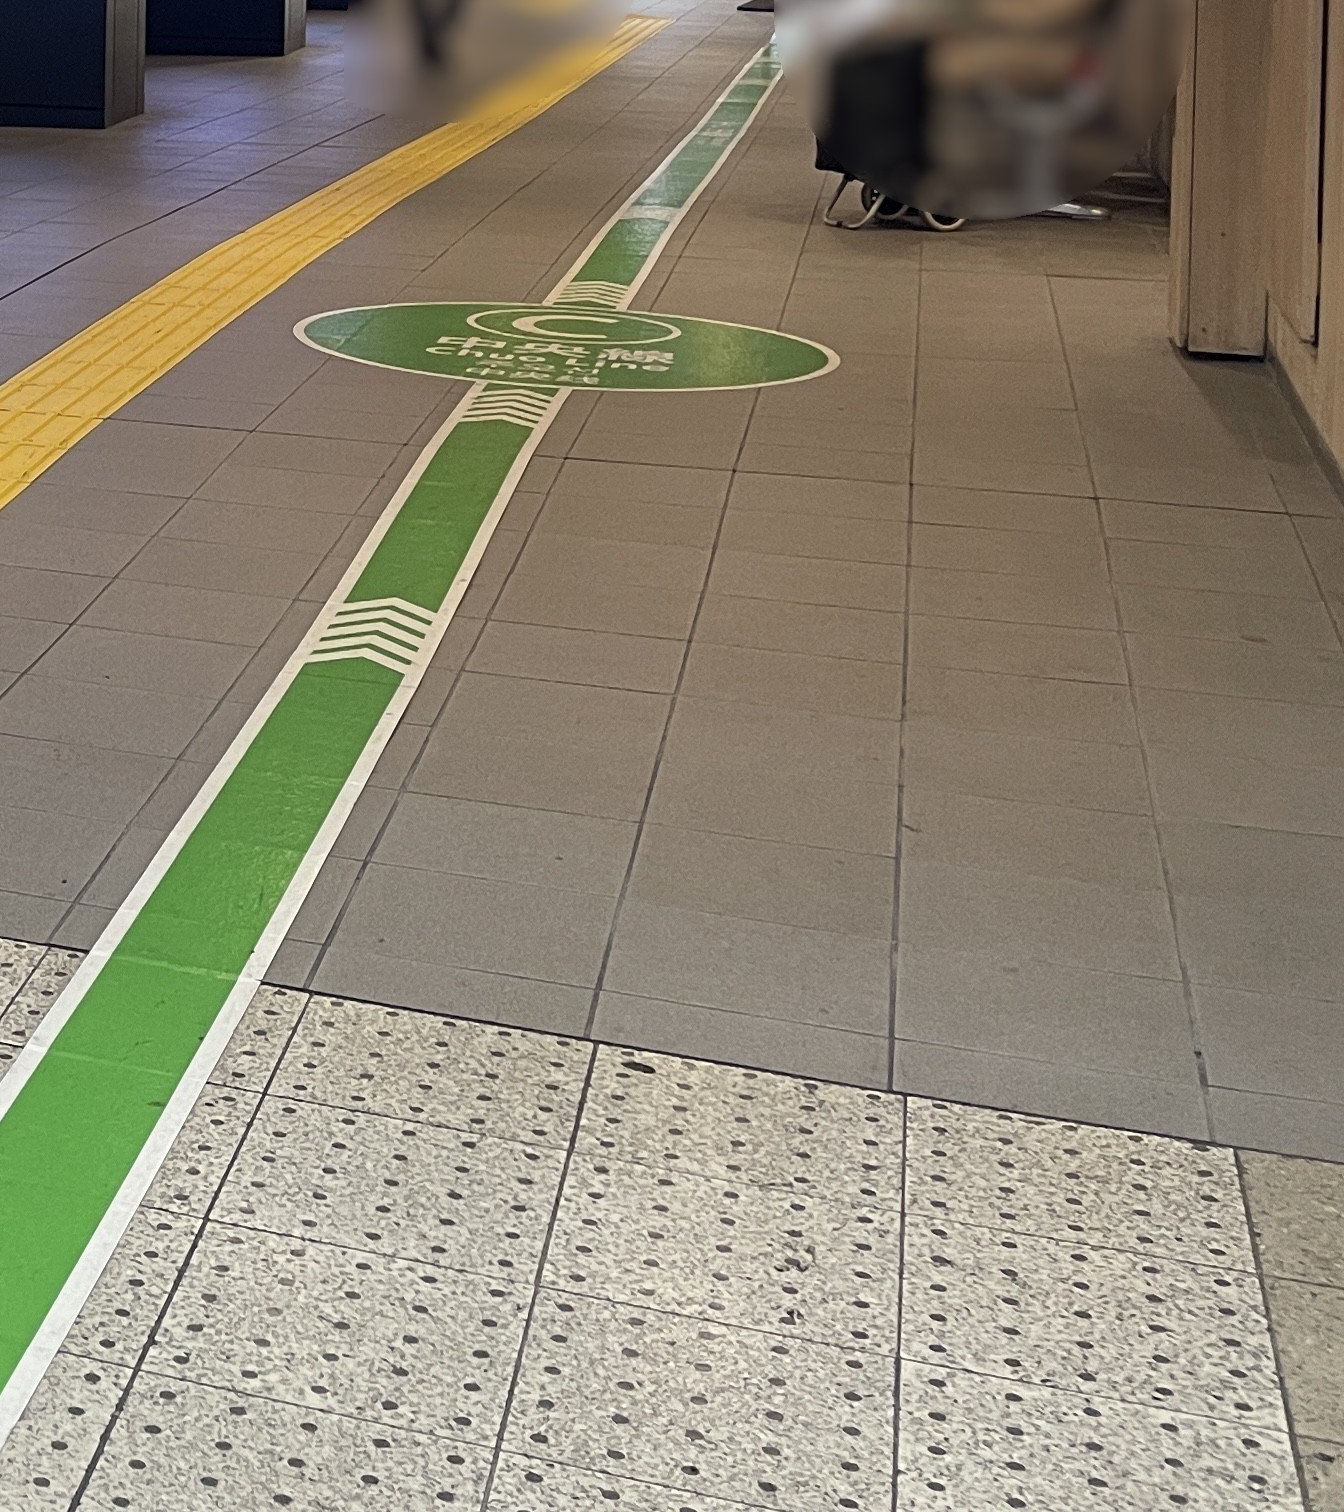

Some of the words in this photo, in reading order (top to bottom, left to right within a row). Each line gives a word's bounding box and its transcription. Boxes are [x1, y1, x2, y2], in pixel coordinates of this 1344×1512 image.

[512, 314, 620, 339] C
[425, 346, 546, 362] Chuo
[566, 358, 670, 372] Line
[437, 336, 675, 365] 中央線
